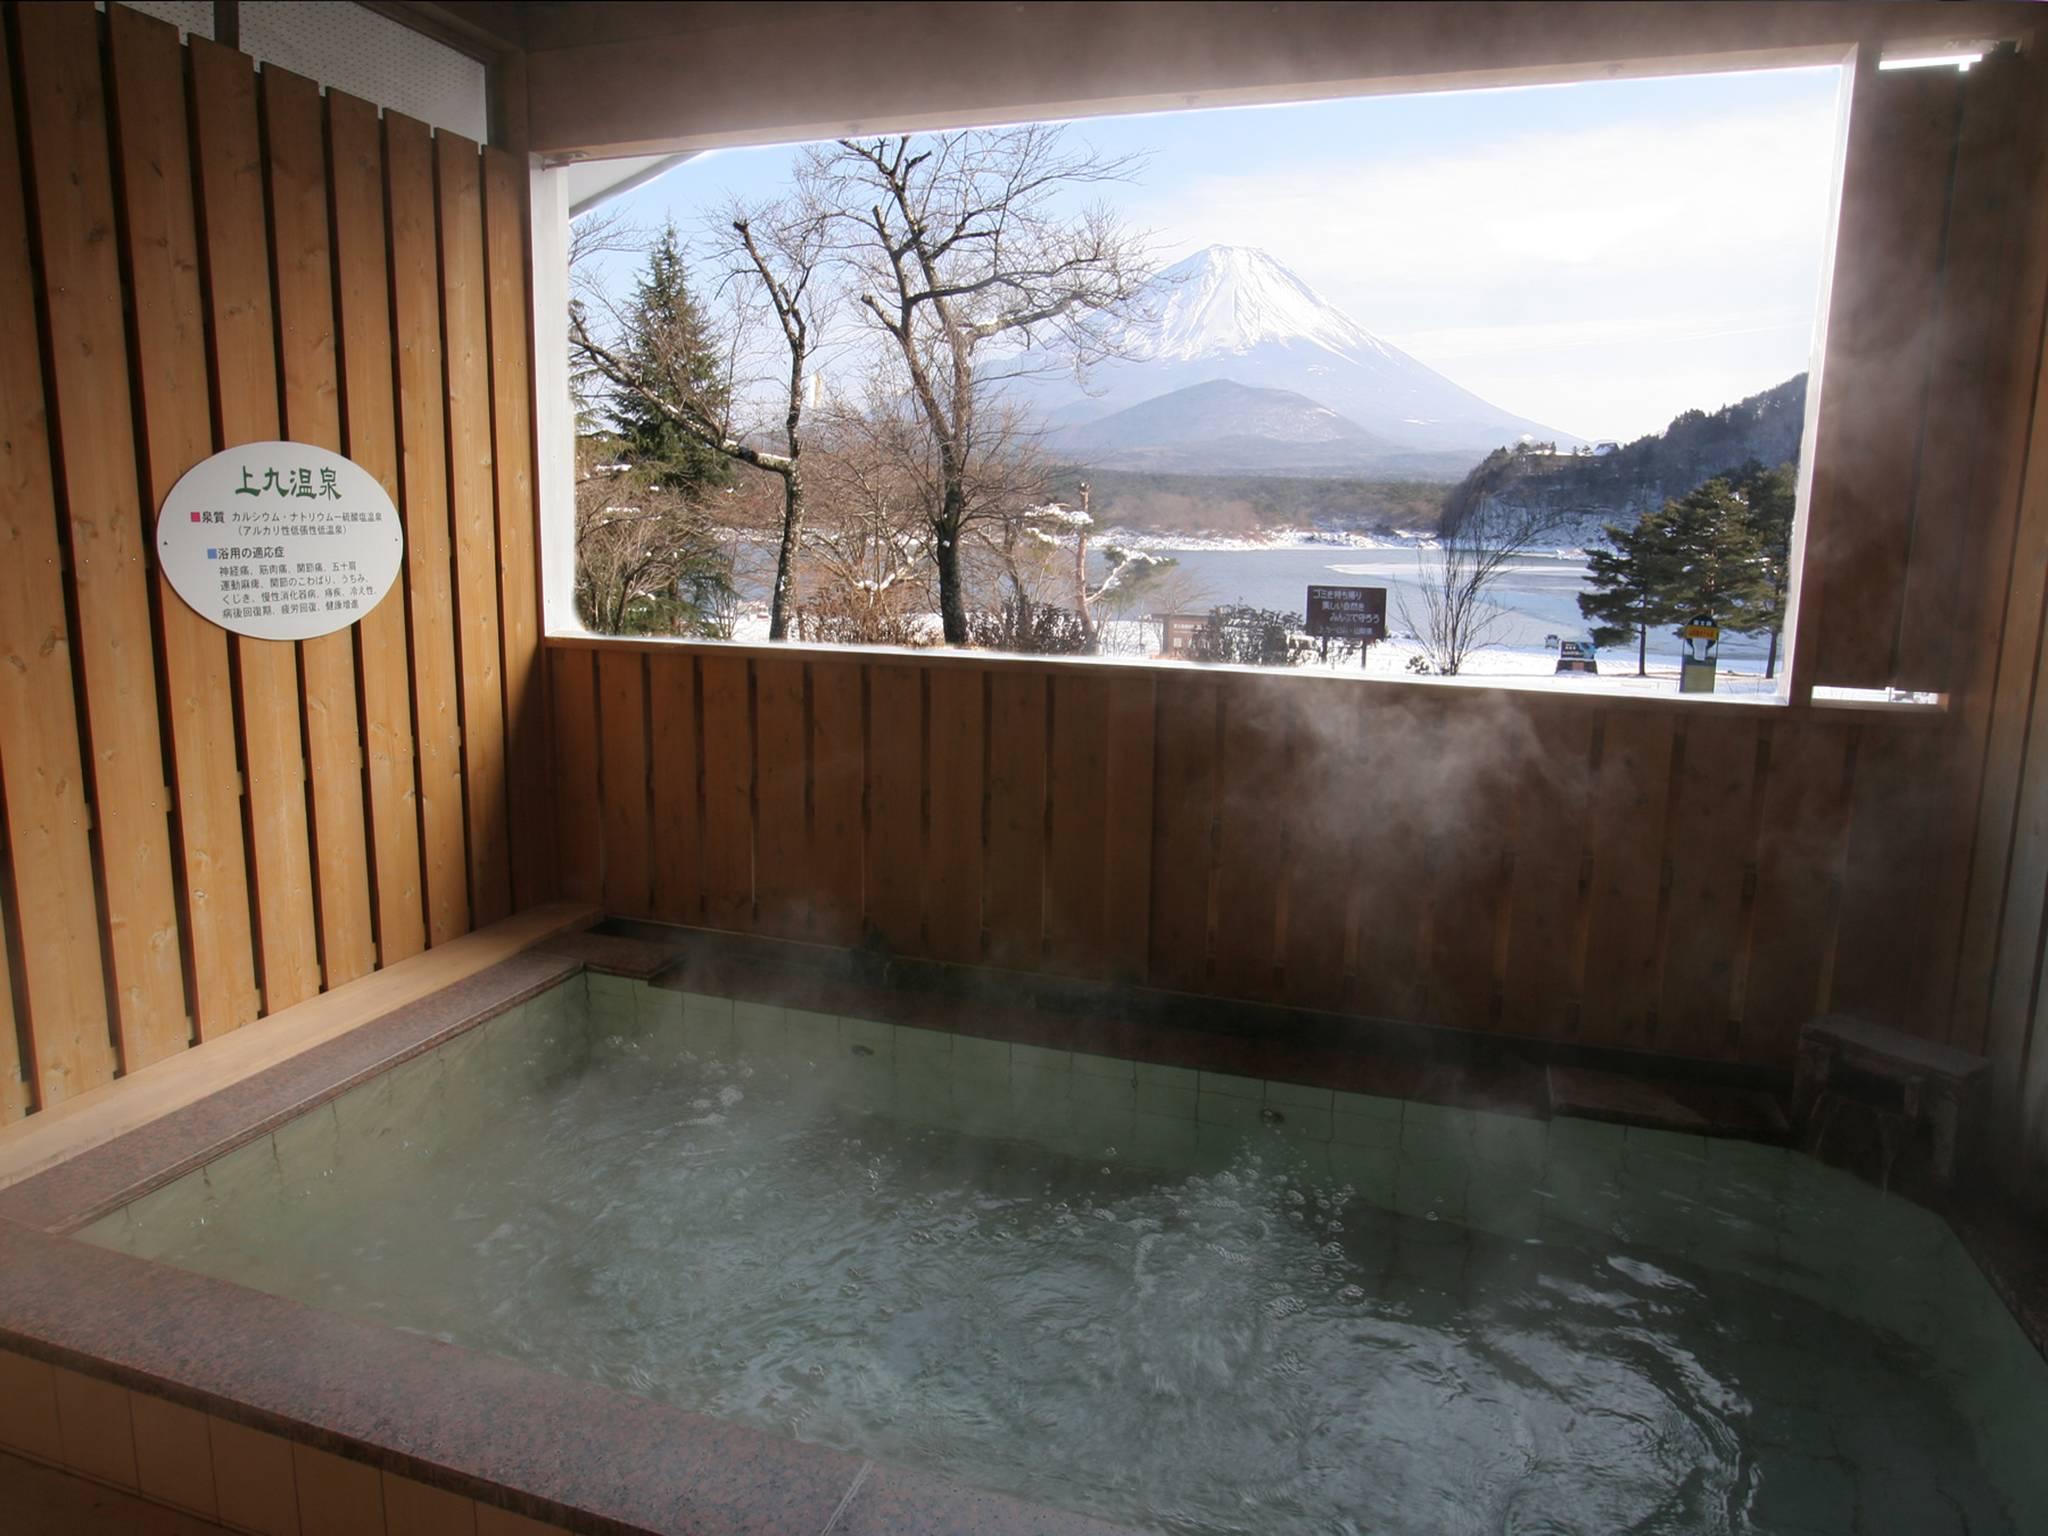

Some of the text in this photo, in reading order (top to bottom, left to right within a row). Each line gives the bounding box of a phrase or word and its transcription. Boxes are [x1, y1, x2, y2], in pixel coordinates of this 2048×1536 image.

[235, 465, 342, 501] 上九温泉
[202, 510, 225, 524] 泉質
[218, 546, 285, 560] 浴用の適応症
